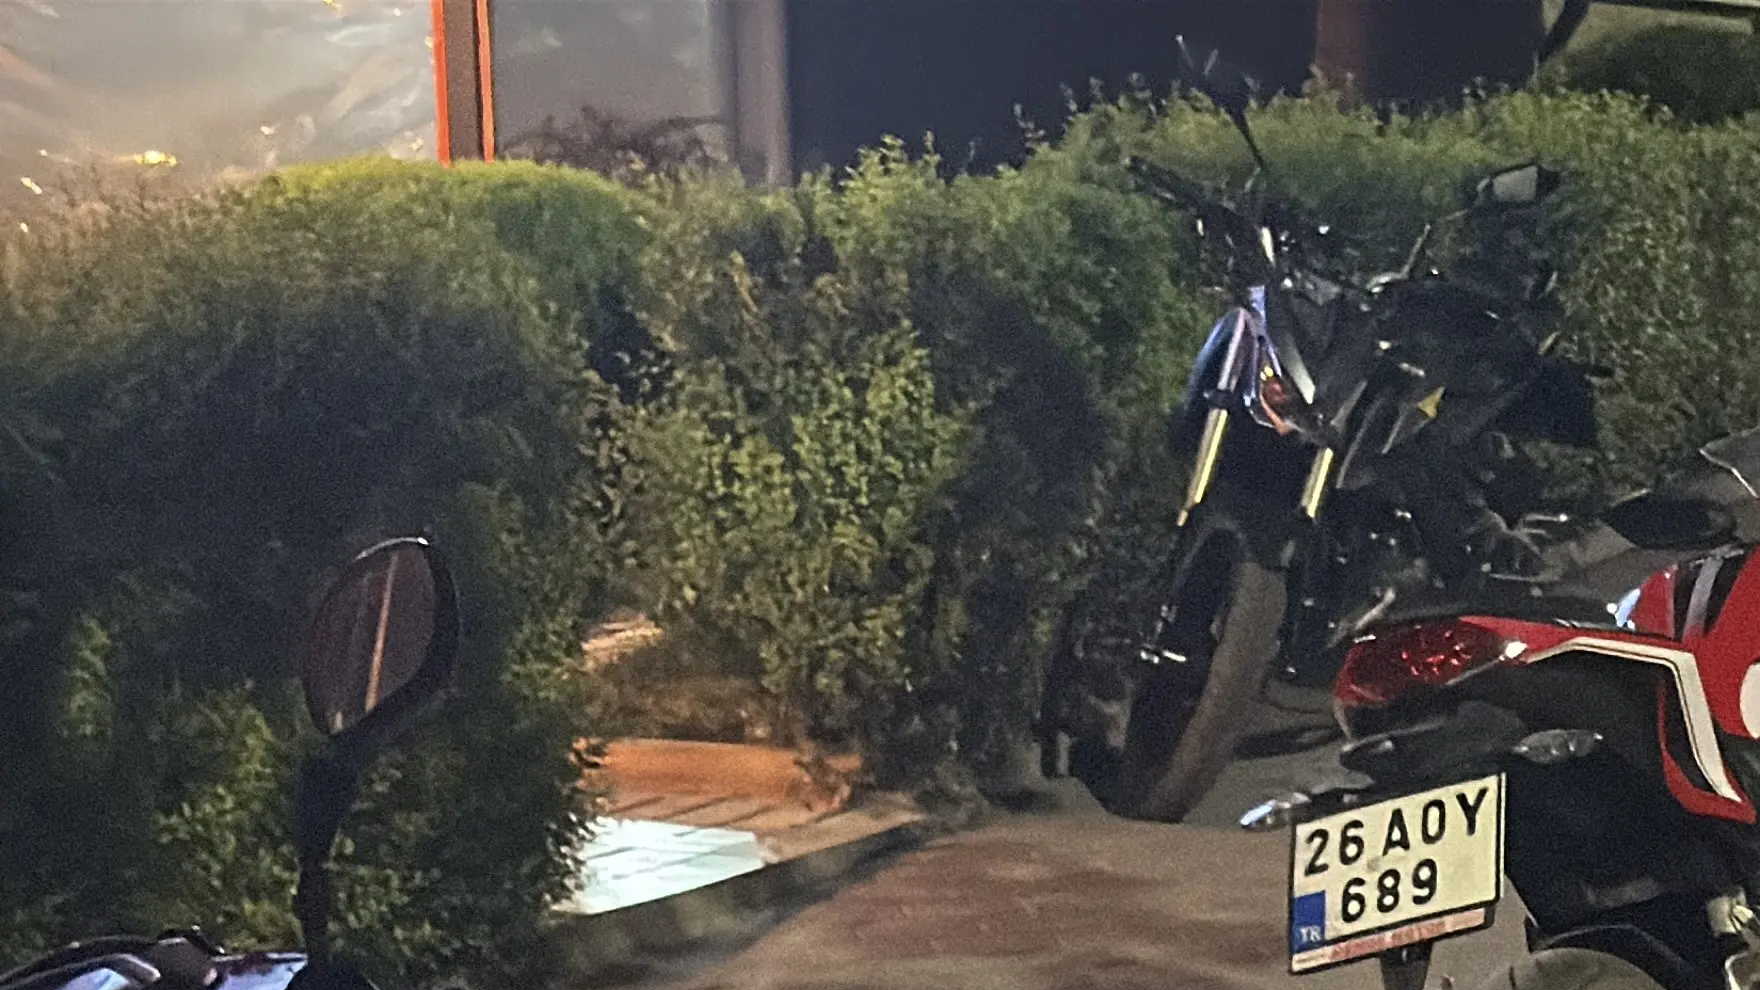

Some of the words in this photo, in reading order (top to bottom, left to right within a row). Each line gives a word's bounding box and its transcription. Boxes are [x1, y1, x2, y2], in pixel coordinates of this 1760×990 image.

[1304, 819, 1365, 877] 26
[1382, 787, 1489, 857] AOY
[1341, 858, 1438, 923] 689
[1300, 925, 1321, 943] TR
